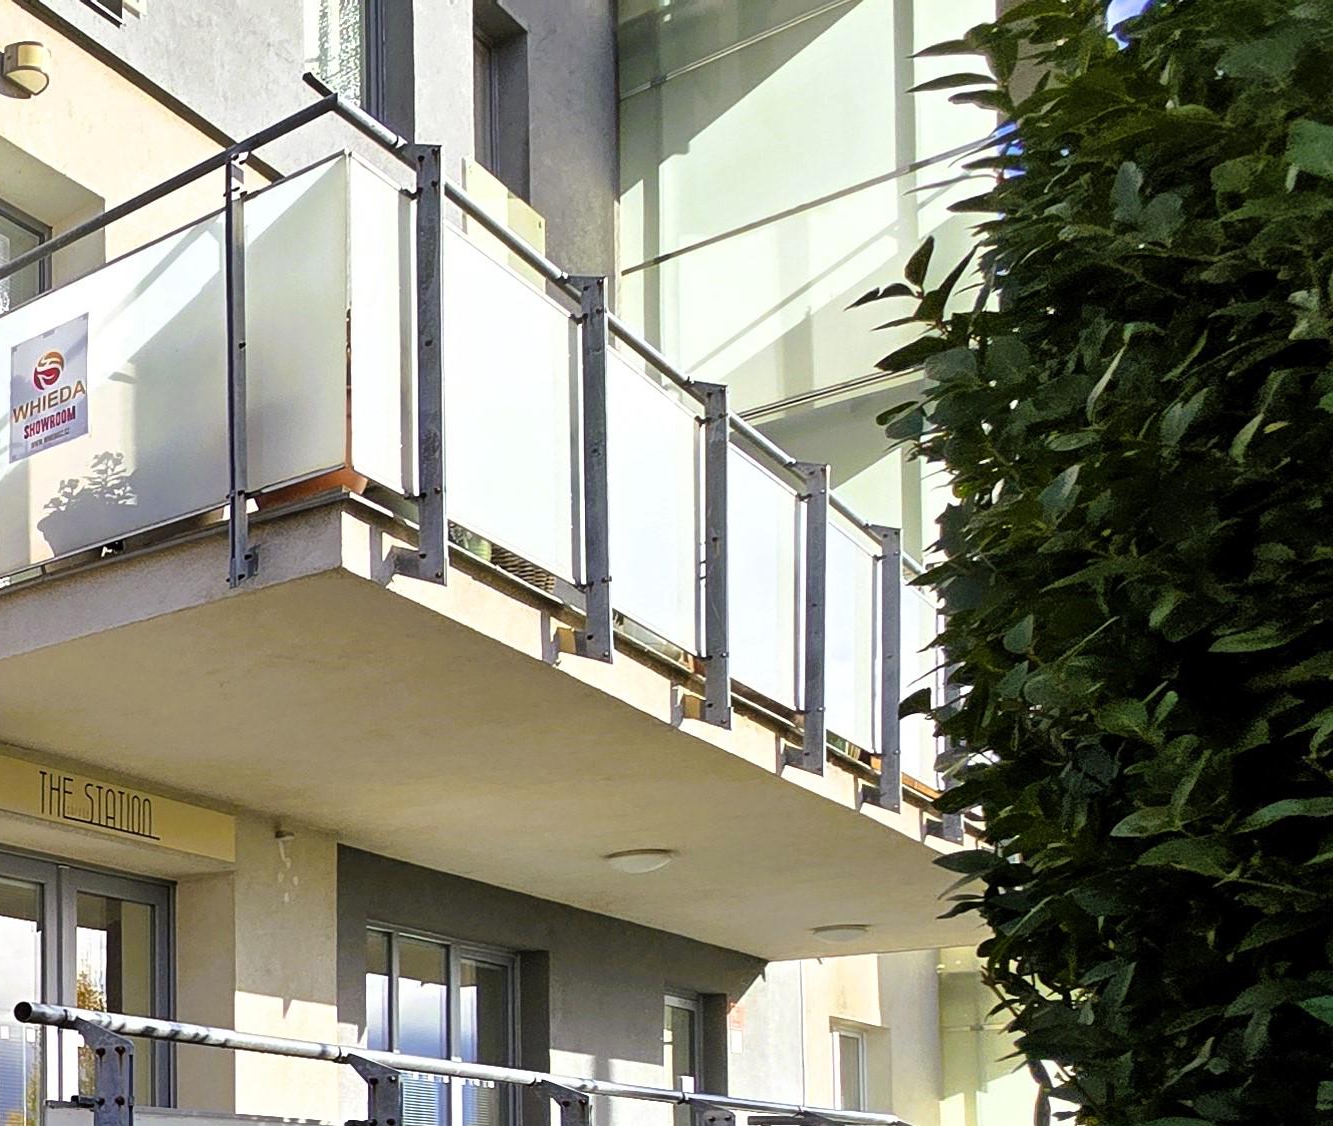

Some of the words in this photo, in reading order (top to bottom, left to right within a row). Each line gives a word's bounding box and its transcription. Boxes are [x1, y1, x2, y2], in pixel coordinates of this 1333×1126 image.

[13, 380, 86, 424] WHIEDA
[24, 405, 76, 440] SHOWROOM
[39, 771, 73, 817] THE
[84, 783, 153, 839] STATION
